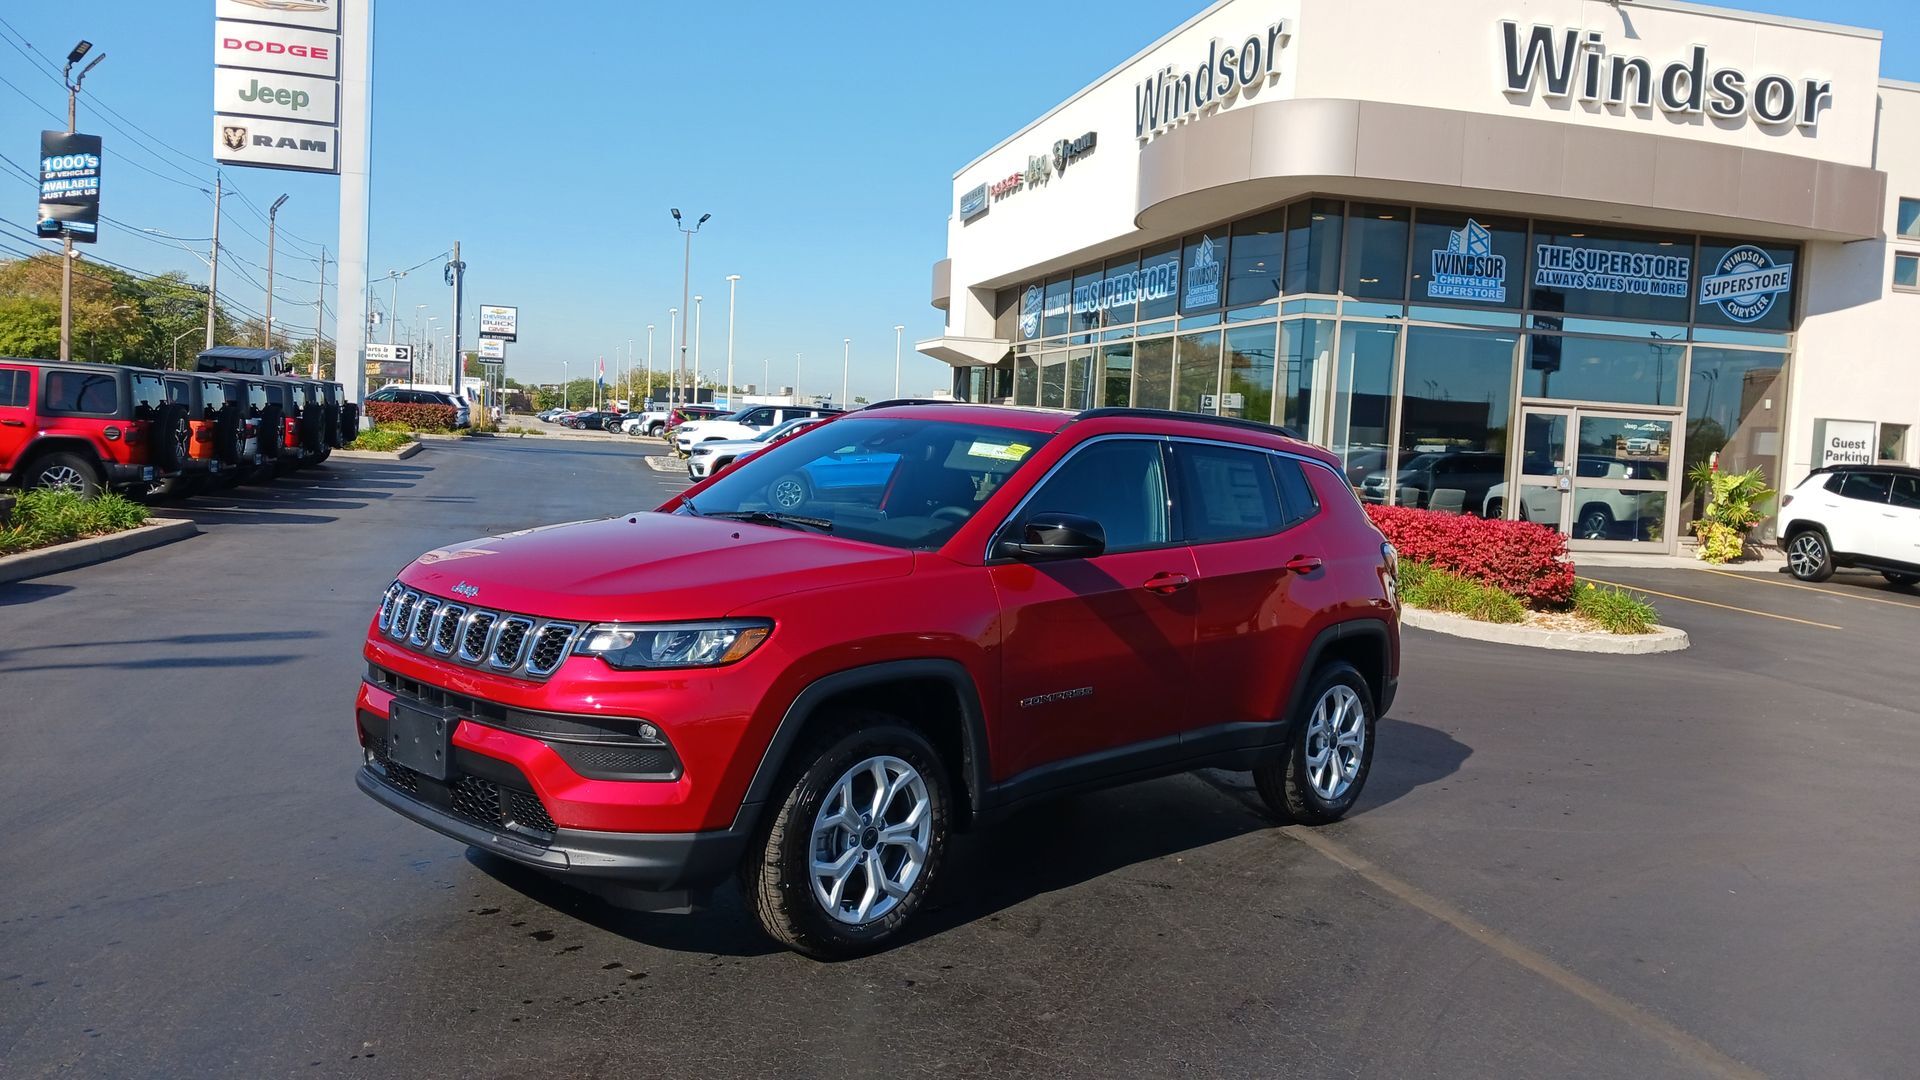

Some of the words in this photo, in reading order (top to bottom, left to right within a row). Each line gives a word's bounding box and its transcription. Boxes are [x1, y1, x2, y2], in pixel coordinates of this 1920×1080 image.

[223, 38, 328, 60] DODGE
[1135, 20, 1284, 139] Windsor
[1501, 20, 1832, 126] Windsor
[238, 79, 309, 111] Jeep
[252, 135, 326, 153] RAM
[43, 154, 98, 171] 1000's
[57, 169, 95, 177] VEHICLES
[43, 178, 97, 191] AVAILABLE
[42, 192, 63, 200] JUST
[1435, 253, 1503, 278] WINDSOR
[1539, 246, 1571, 267] THE
[1574, 250, 1687, 279] SUPERSTORE
[1723, 251, 1765, 272] WINDSOR
[1073, 286, 1089, 313] THE
[1089, 262, 1178, 312] SUPERSTORE
[1431, 285, 1503, 298] SUPERSTORE
[1440, 275, 1496, 288] CHRYSLER
[1537, 271, 1583, 288] ALWAYS
[1586, 274, 1624, 291] SAVES
[1626, 280, 1648, 294] YOU
[1650, 281, 1686, 296] MORE!
[1704, 272, 1788, 297] SUPERSTORE
[1727, 296, 1769, 318] CHRYSLER
[1831, 437, 1866, 449] Guest
[1825, 450, 1870, 465] Parking
